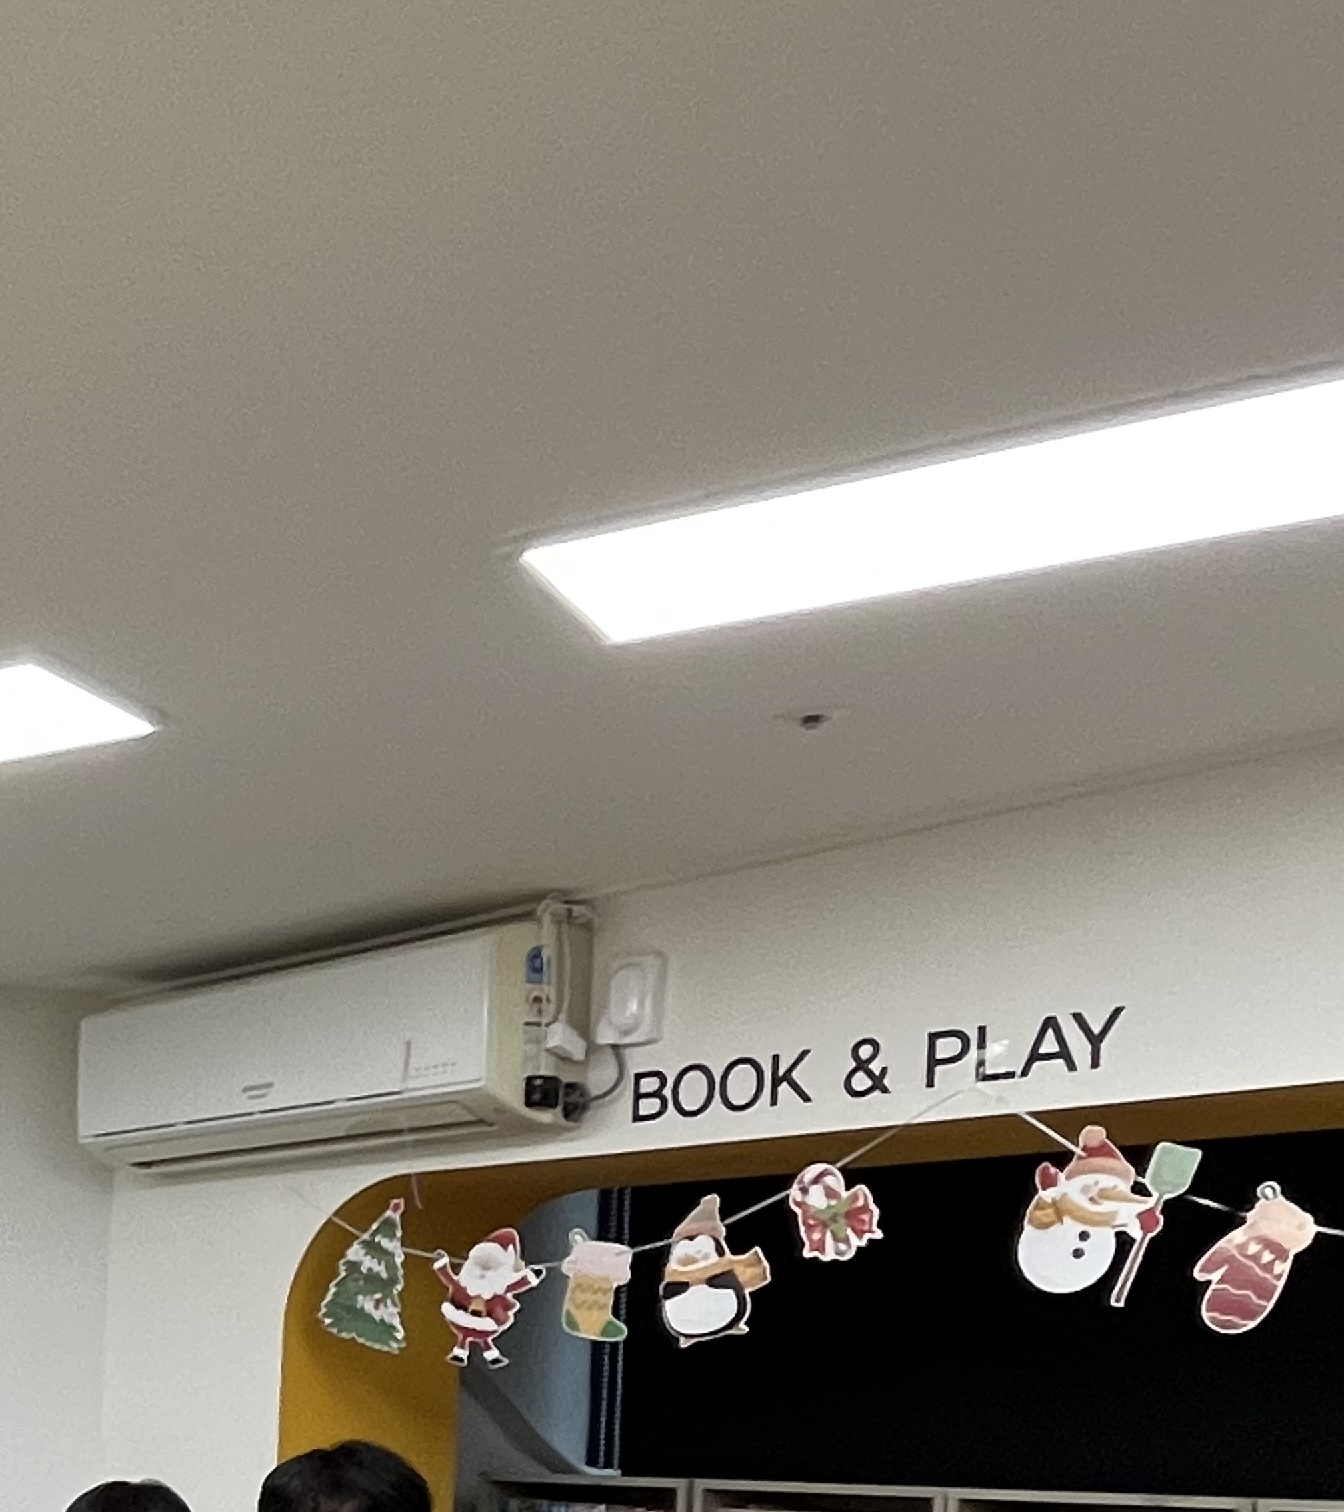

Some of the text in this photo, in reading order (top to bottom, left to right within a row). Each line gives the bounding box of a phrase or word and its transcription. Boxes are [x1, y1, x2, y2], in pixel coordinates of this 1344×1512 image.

[631, 1005, 1126, 1124] BOOK & PLAY
